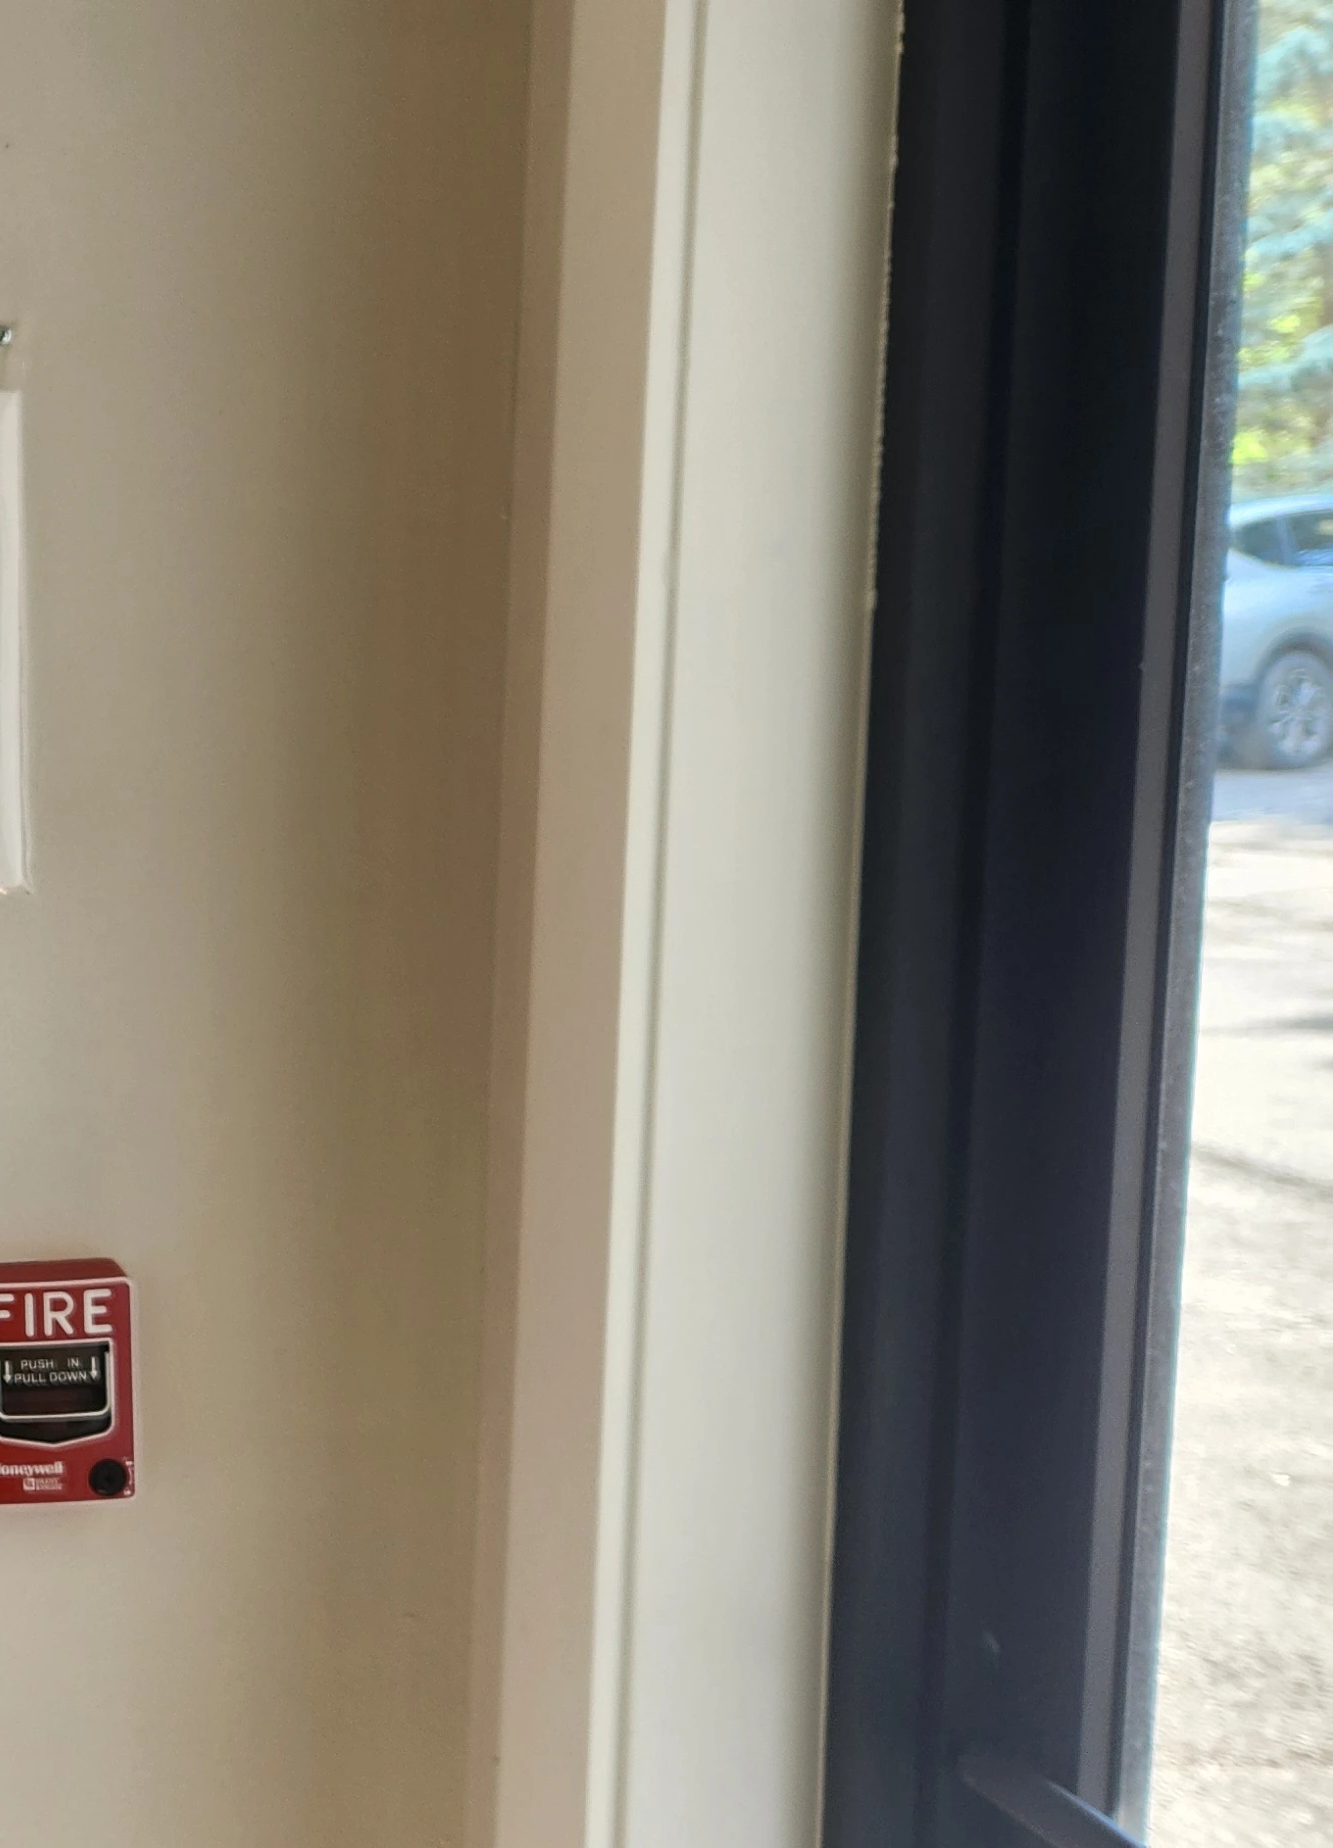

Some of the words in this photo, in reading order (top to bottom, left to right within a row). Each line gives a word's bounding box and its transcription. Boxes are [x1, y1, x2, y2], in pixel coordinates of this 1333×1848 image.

[20, 1359, 54, 1369] PUSH
[67, 1358, 80, 1367] IN
[14, 1373, 46, 1383] PULL
[49, 1371, 87, 1381] DOWN
